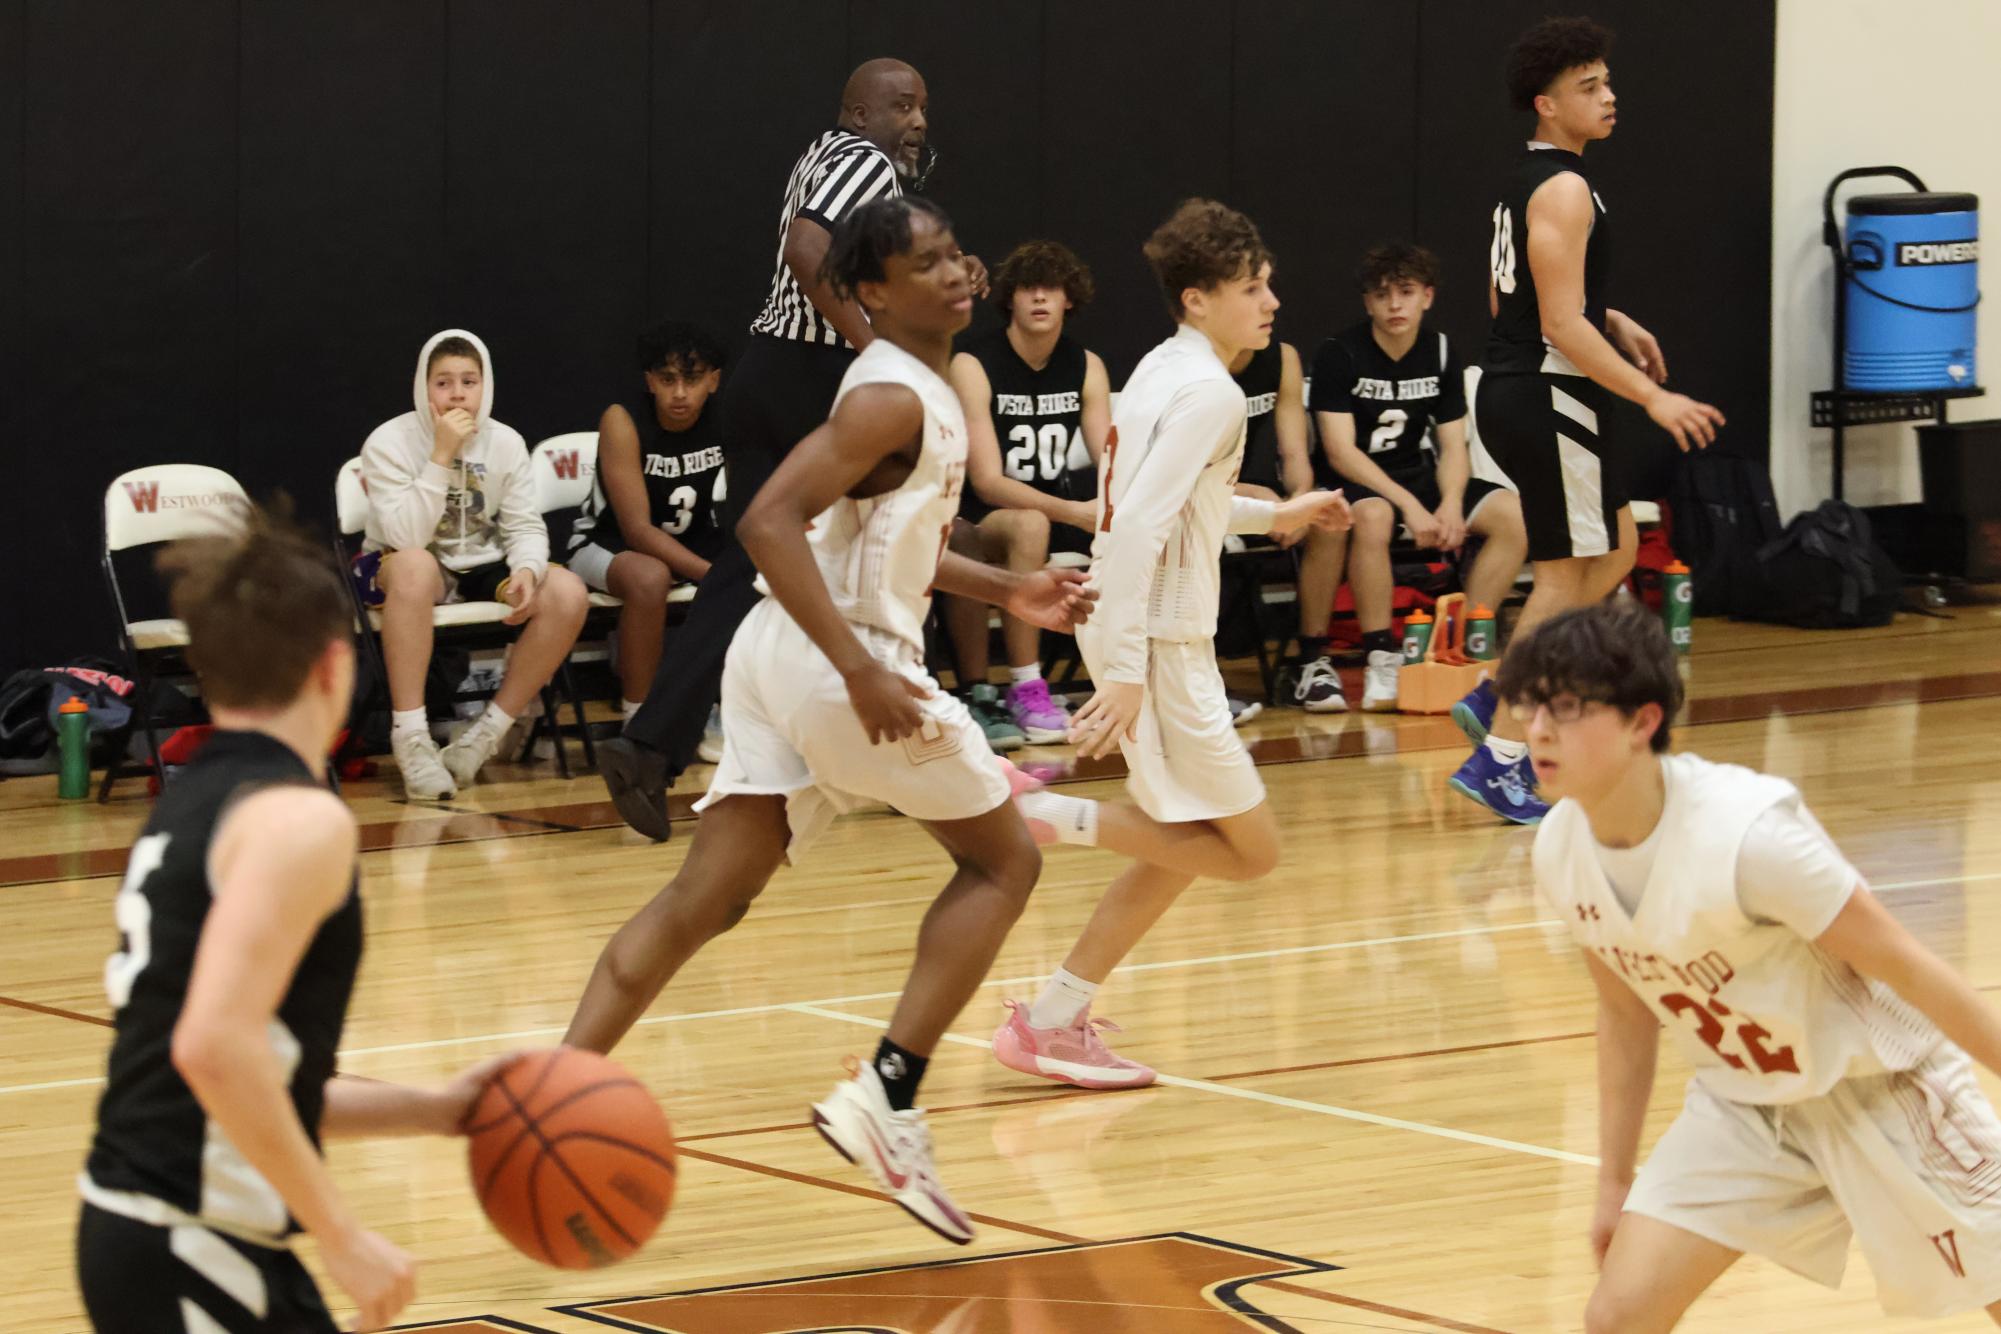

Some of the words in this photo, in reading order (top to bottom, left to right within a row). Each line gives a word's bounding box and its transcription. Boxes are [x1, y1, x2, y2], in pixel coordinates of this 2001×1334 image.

[1005, 423, 1068, 481] 20
[1369, 409, 1408, 454] 2
[662, 485, 697, 535] 3
[1468, 632, 1487, 653] G
[1659, 993, 1801, 1075] 22
